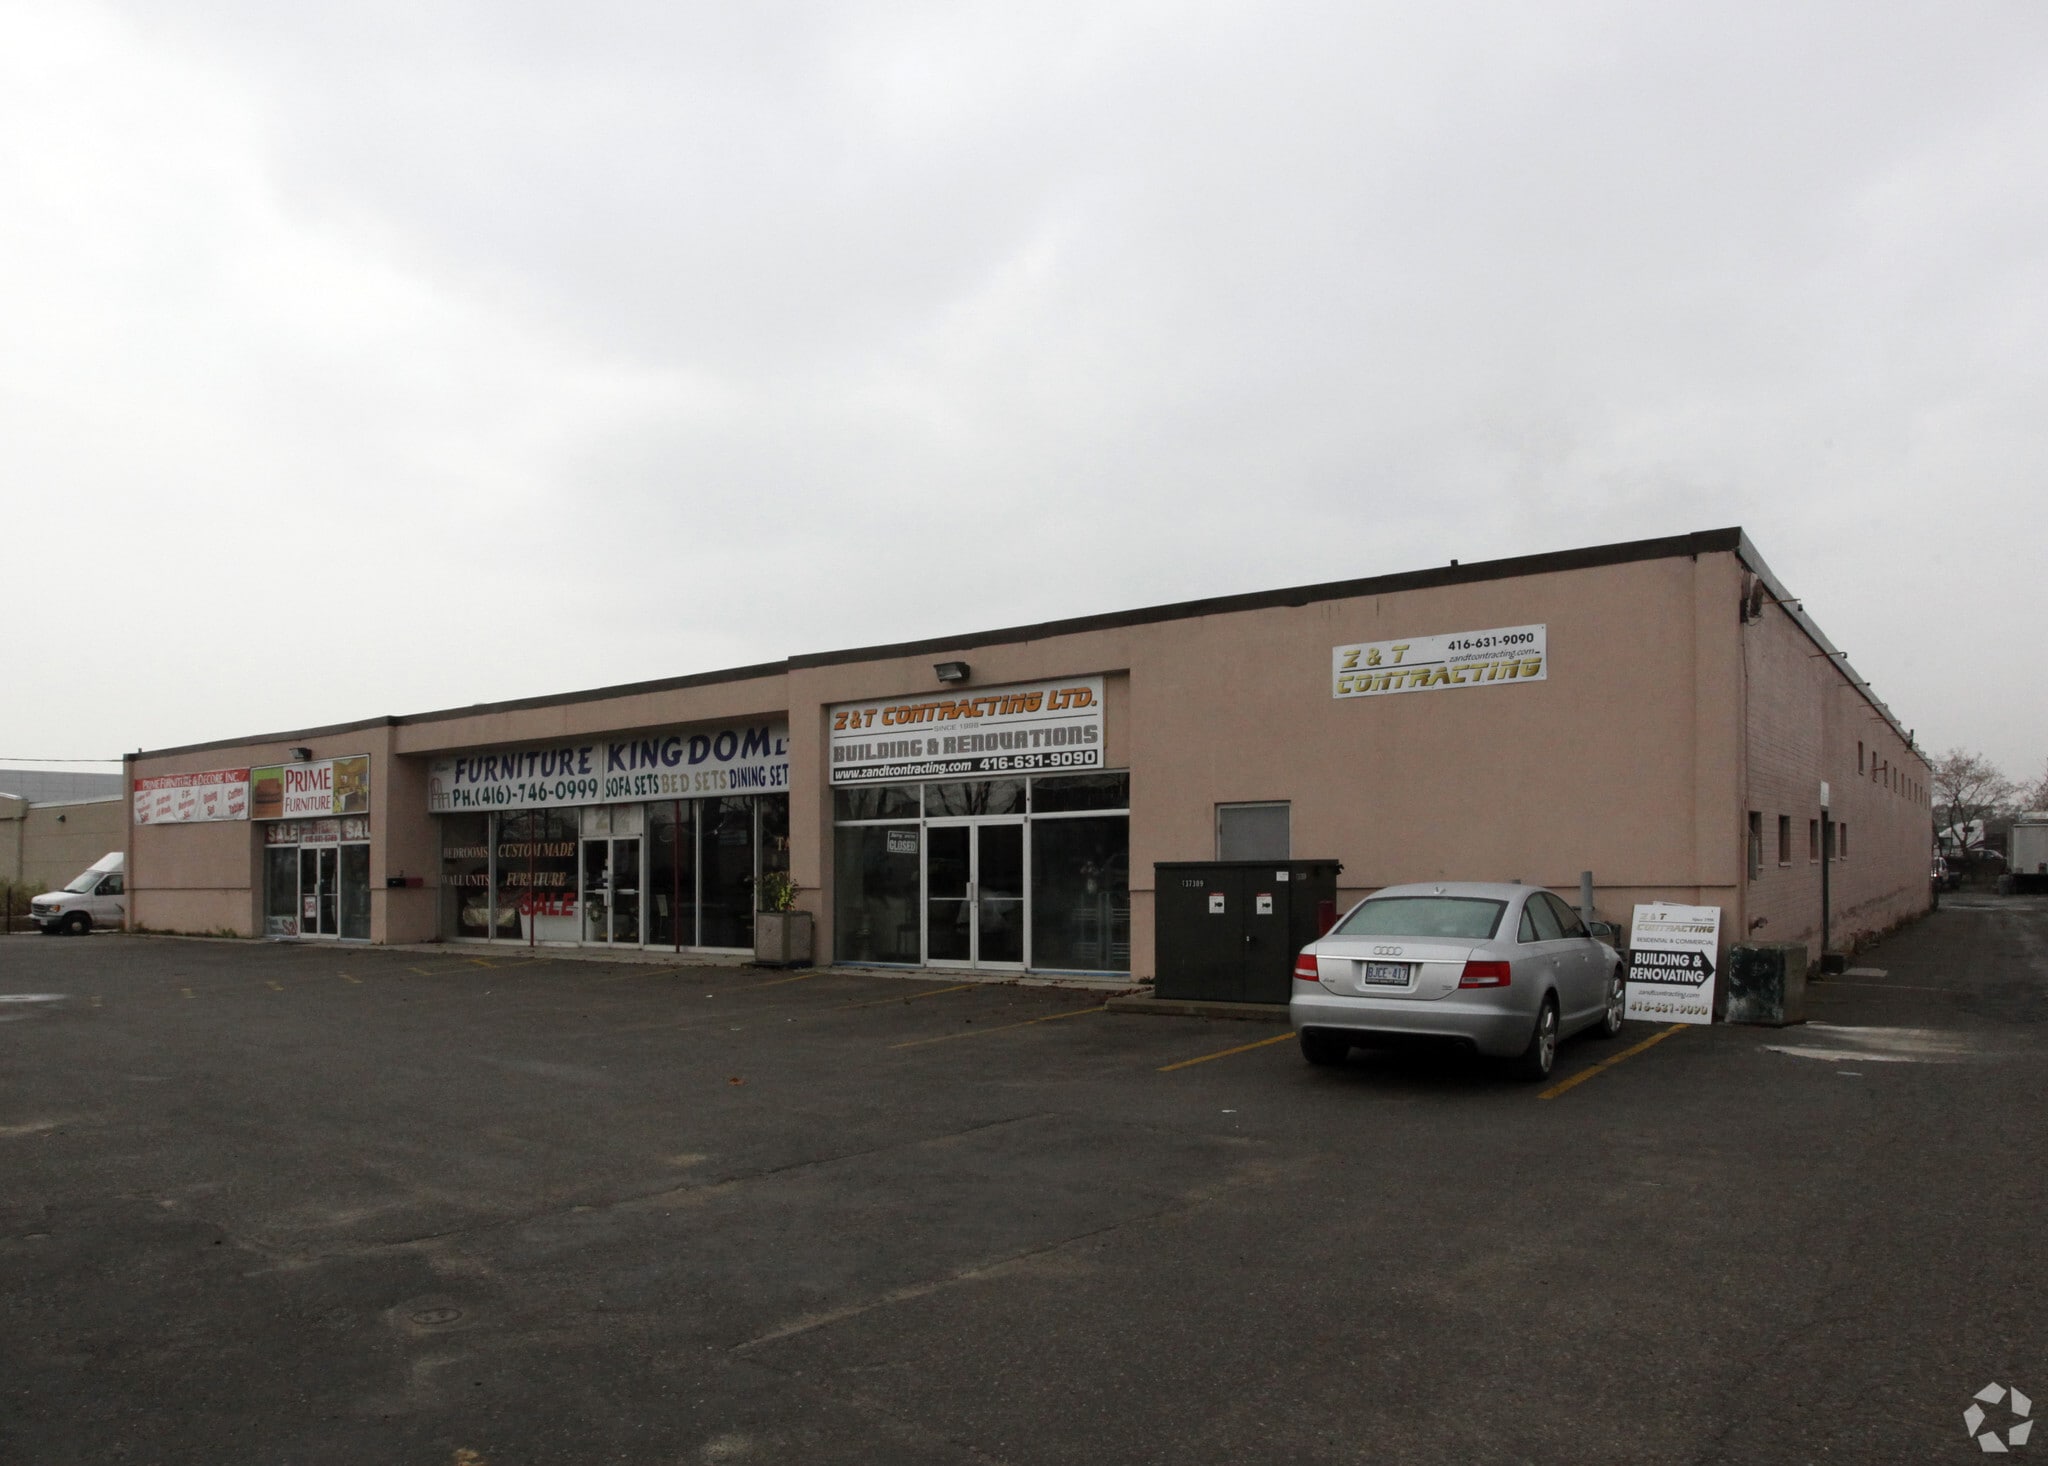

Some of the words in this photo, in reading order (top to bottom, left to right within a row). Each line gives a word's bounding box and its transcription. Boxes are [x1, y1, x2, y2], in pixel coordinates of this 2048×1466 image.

[1448, 632, 1534, 651] 416-631-9090
[1342, 649, 1361, 669] Z
[1366, 647, 1382, 667] &
[1391, 643, 1410, 664] T
[1449, 648, 1535, 663] zandtcontracting.com
[1336, 657, 1542, 694] CONTRACTING
[833, 708, 878, 731] Z&T
[881, 691, 1044, 726] CONTRACTING
[1047, 687, 1098, 711] LTD.
[933, 724, 957, 732] SINCE
[833, 739, 923, 763] BUILDING
[926, 738, 939, 756] &
[943, 724, 1098, 755] RENOVATIONS
[455, 746, 594, 784] FURNITURE
[607, 726, 771, 773] KINGDOM
[775, 738, 790, 756] L
[834, 761, 972, 780] www.zandtcontracting.com
[980, 751, 1096, 770] 416-631-9090
[285, 767, 332, 794] PRIME
[605, 775, 632, 798] SOFA
[634, 773, 660, 795] SETS
[661, 773, 690, 794] BED
[695, 769, 727, 792] SETS
[729, 765, 766, 789] DINING
[285, 795, 331, 812] FURNITURE
[268, 824, 297, 841] SALE
[443, 846, 489, 859] BEDROOMS
[542, 842, 576, 857] MADE
[889, 840, 916, 852] CLOSED
[465, 873, 490, 886] UNITS
[520, 892, 576, 917] SALE
[1637, 924, 1715, 933] CONTRACTING
[1634, 952, 1690, 967] BUILDING
[1692, 955, 1702, 967] &
[1629, 967, 1705, 983] RENOVATING
